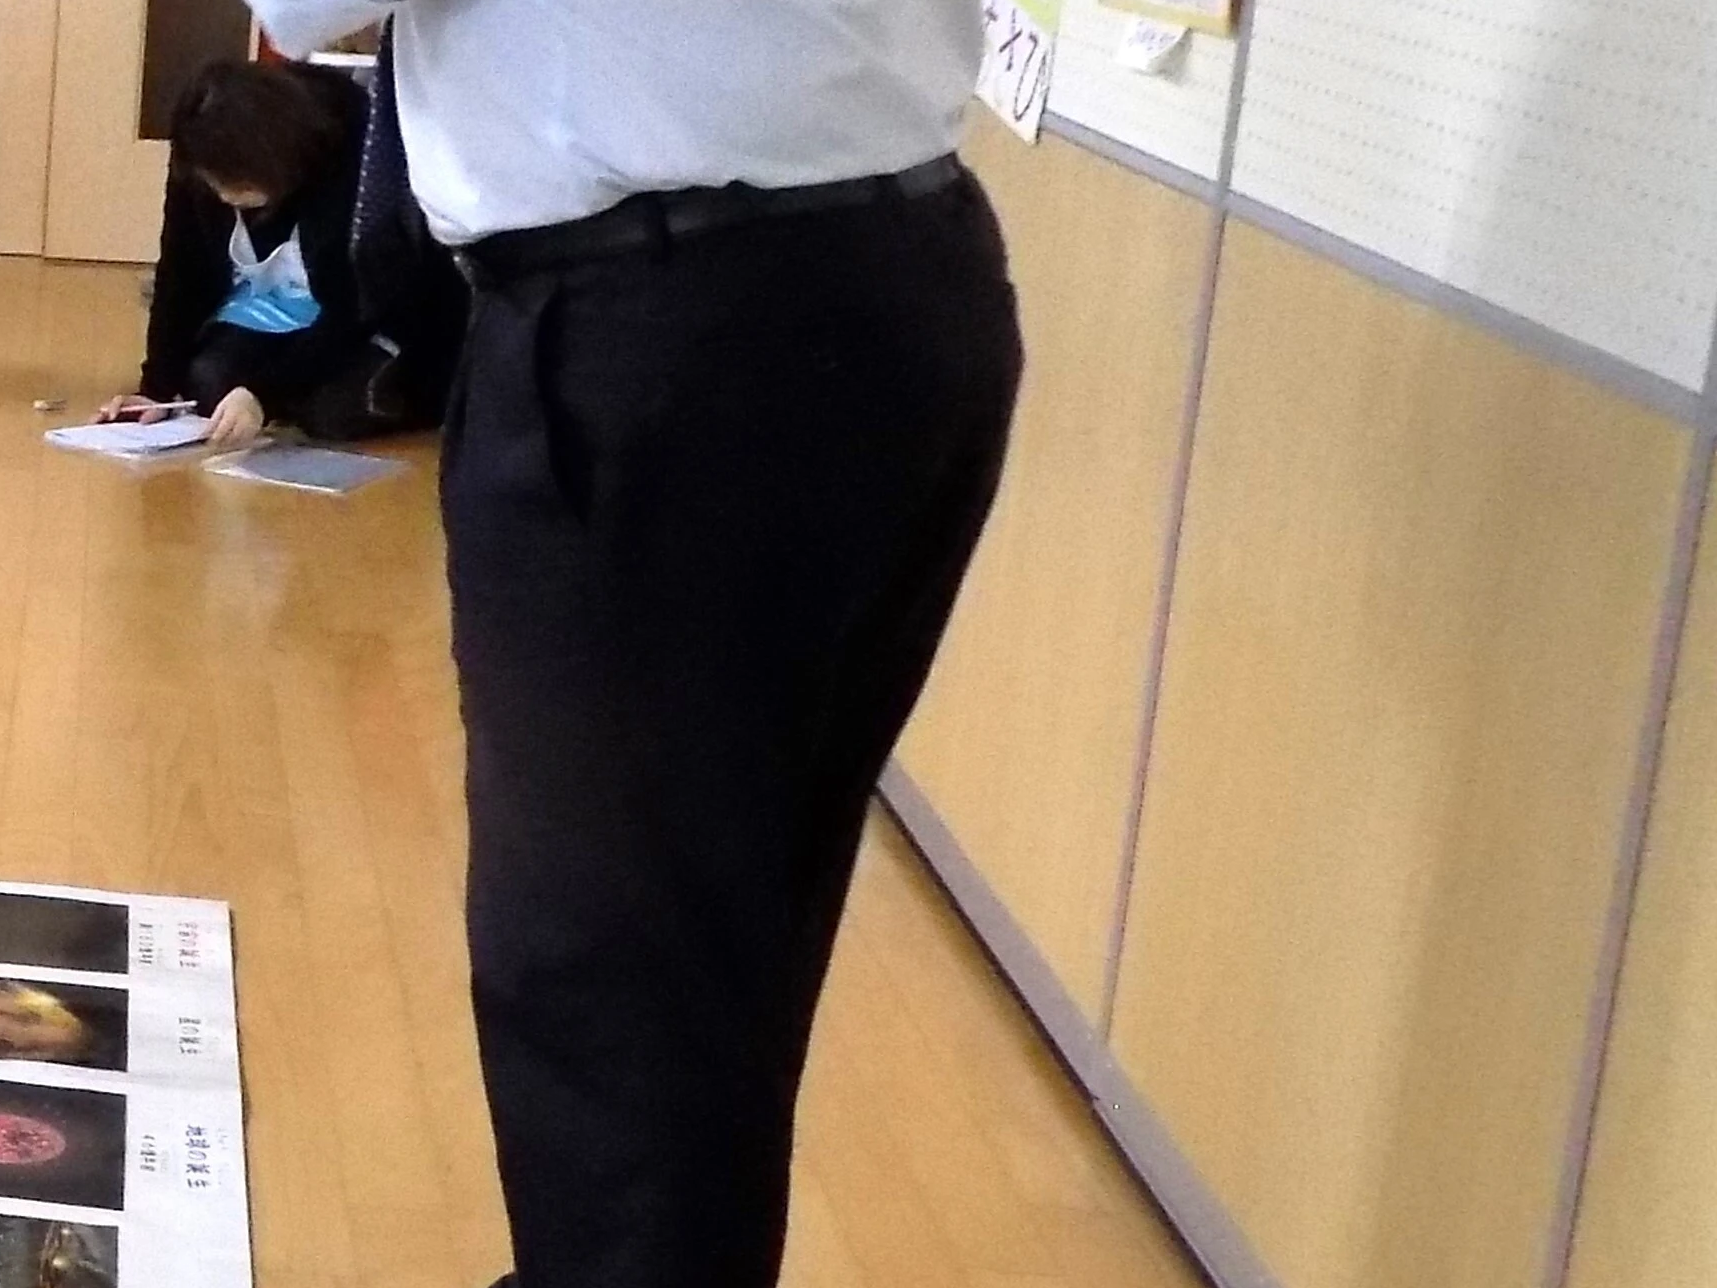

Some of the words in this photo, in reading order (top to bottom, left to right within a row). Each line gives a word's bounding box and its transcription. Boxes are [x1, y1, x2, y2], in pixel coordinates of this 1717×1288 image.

[184, 1123, 212, 1189] 地球の誕生
